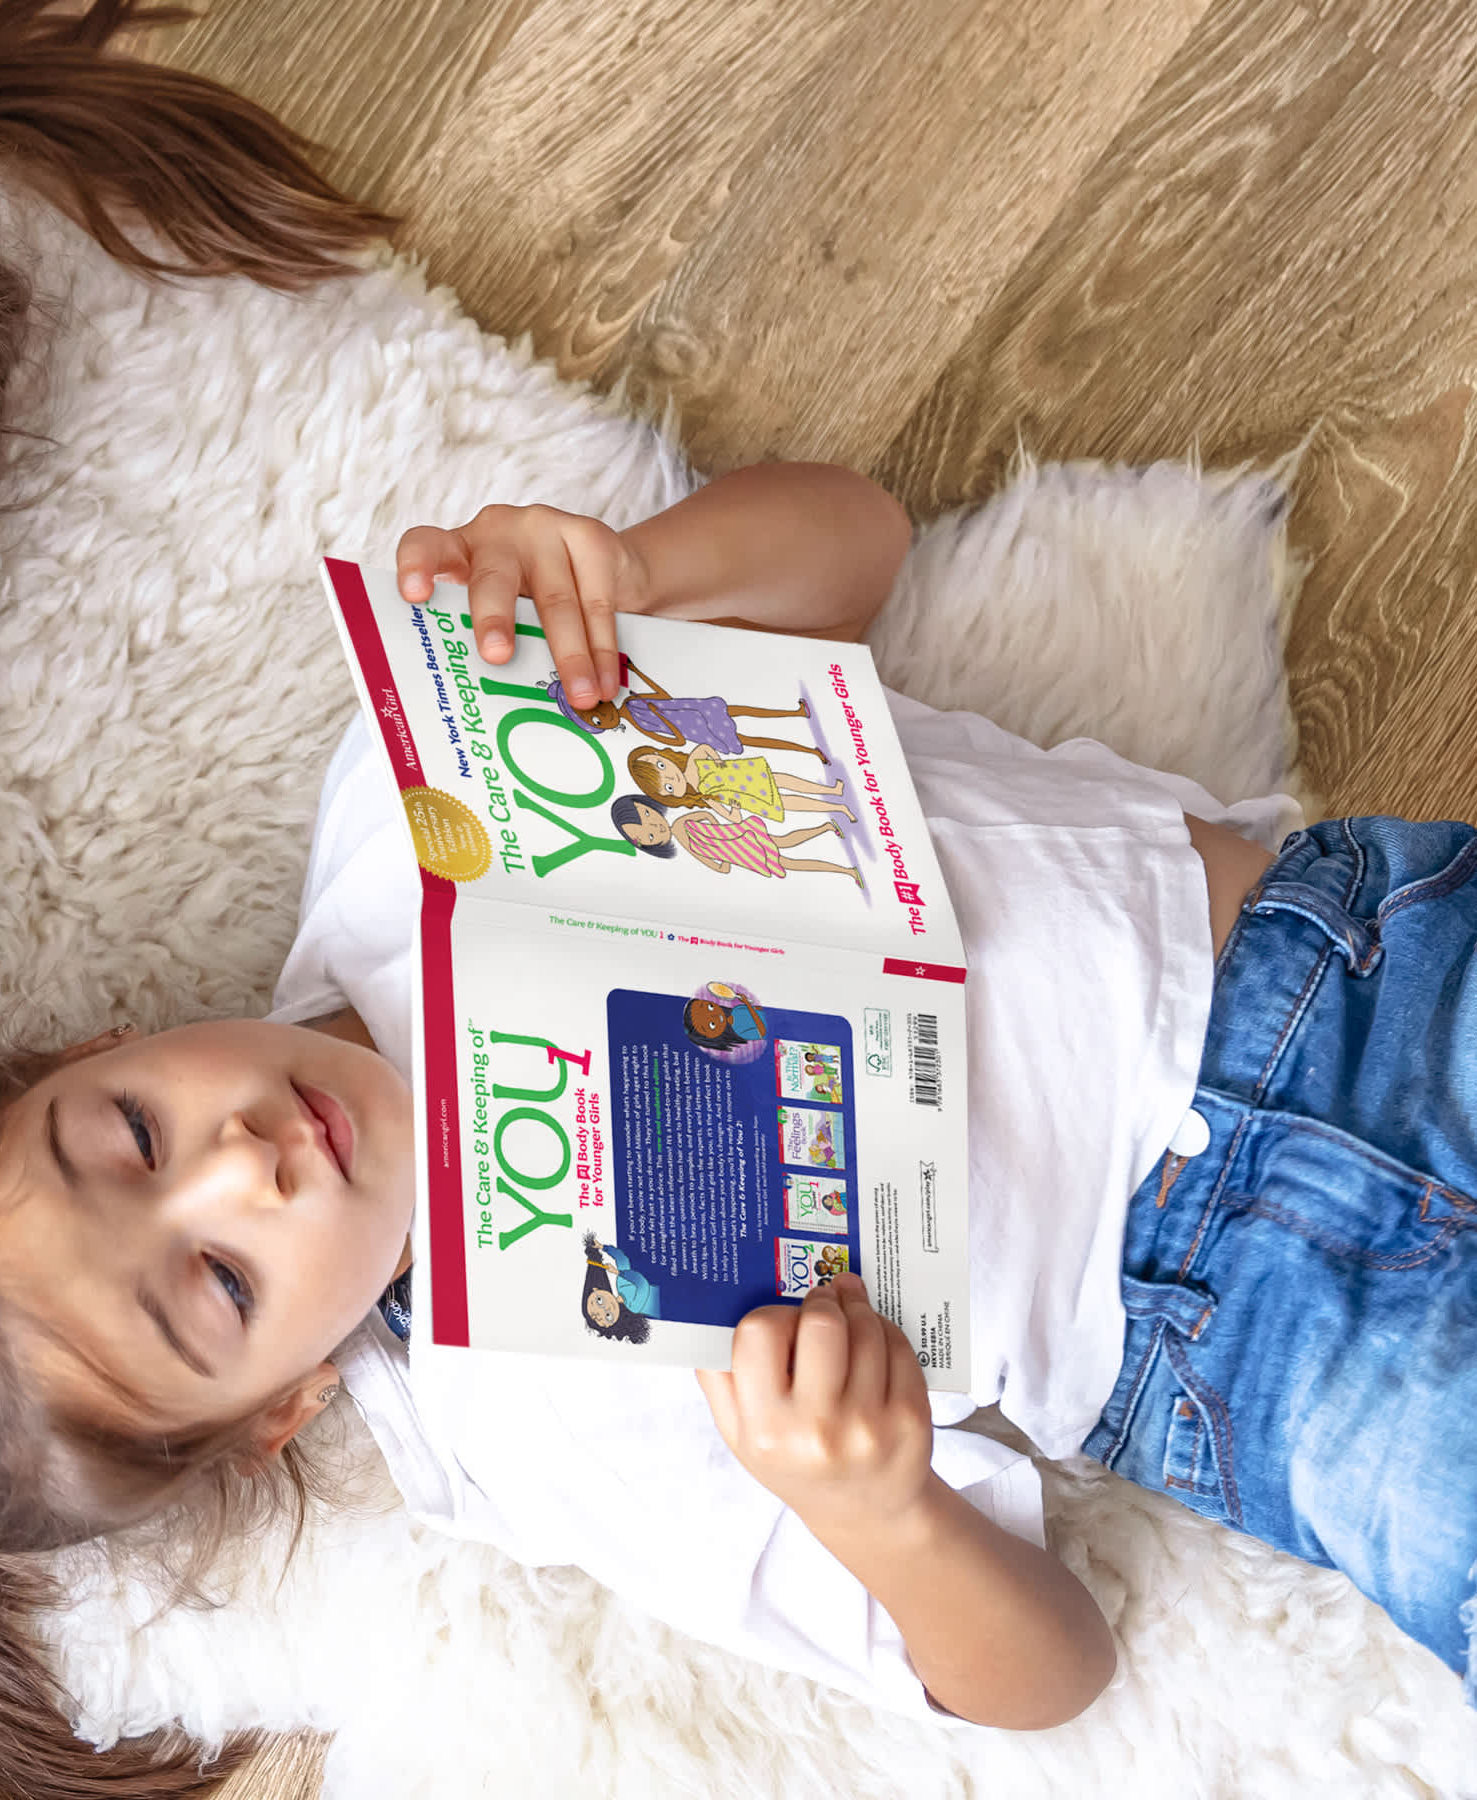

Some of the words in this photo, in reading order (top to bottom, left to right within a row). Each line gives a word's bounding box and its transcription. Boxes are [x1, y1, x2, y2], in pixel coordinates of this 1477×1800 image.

[411, 604, 438, 670] Bestseller
[426, 607, 454, 633] of
[432, 673, 450, 711] Times
[442, 638, 485, 733] Keeping
[828, 663, 848, 698] Girls
[381, 688, 399, 711] Girl
[389, 712, 418, 771] American
[442, 715, 460, 743] York
[841, 701, 870, 765] Younger
[456, 747, 471, 777] New
[471, 740, 492, 759] &
[482, 767, 510, 822] Care
[863, 769, 879, 792] for
[869, 796, 894, 836] Book
[499, 829, 524, 873] The
[884, 839, 908, 879] Body
[908, 906, 925, 934] The
[467, 1027, 483, 1048] of
[470, 1053, 490, 1133] Keeping
[574, 1088, 586, 1123] Book
[588, 1093, 599, 1124] Girls
[440, 1098, 449, 1167] americangirl.com
[474, 1139, 488, 1155] &
[487, 1030, 572, 1250] YOU
[547, 1046, 590, 1074] 1
[576, 1126, 589, 1161] Body
[791, 1111, 802, 1159] Feelings
[588, 1126, 603, 1183] Younger
[476, 1160, 490, 1205] Care
[578, 1183, 589, 1208] The
[592, 1186, 603, 1206] for
[476, 1211, 492, 1248] The
